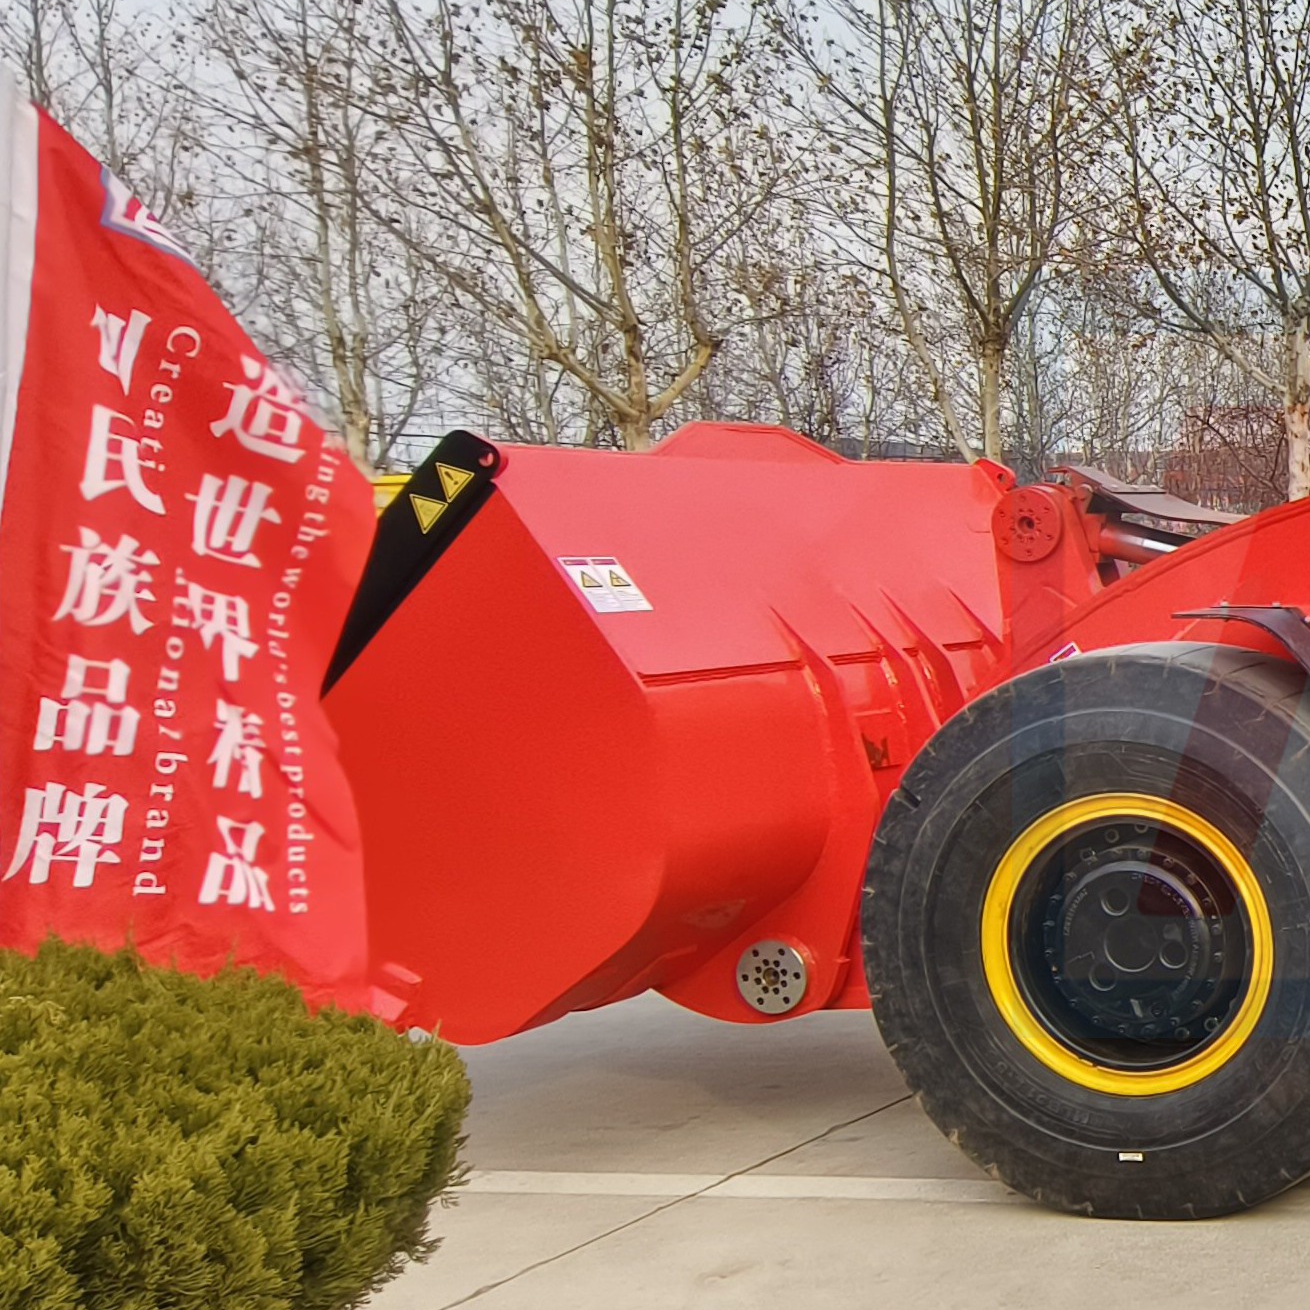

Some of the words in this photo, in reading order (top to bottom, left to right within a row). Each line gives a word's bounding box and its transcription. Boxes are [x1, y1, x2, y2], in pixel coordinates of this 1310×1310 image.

[290, 511, 331, 560] the
[275, 691, 304, 757] best
[132, 750, 190, 897] brand
[280, 763, 315, 914] products
